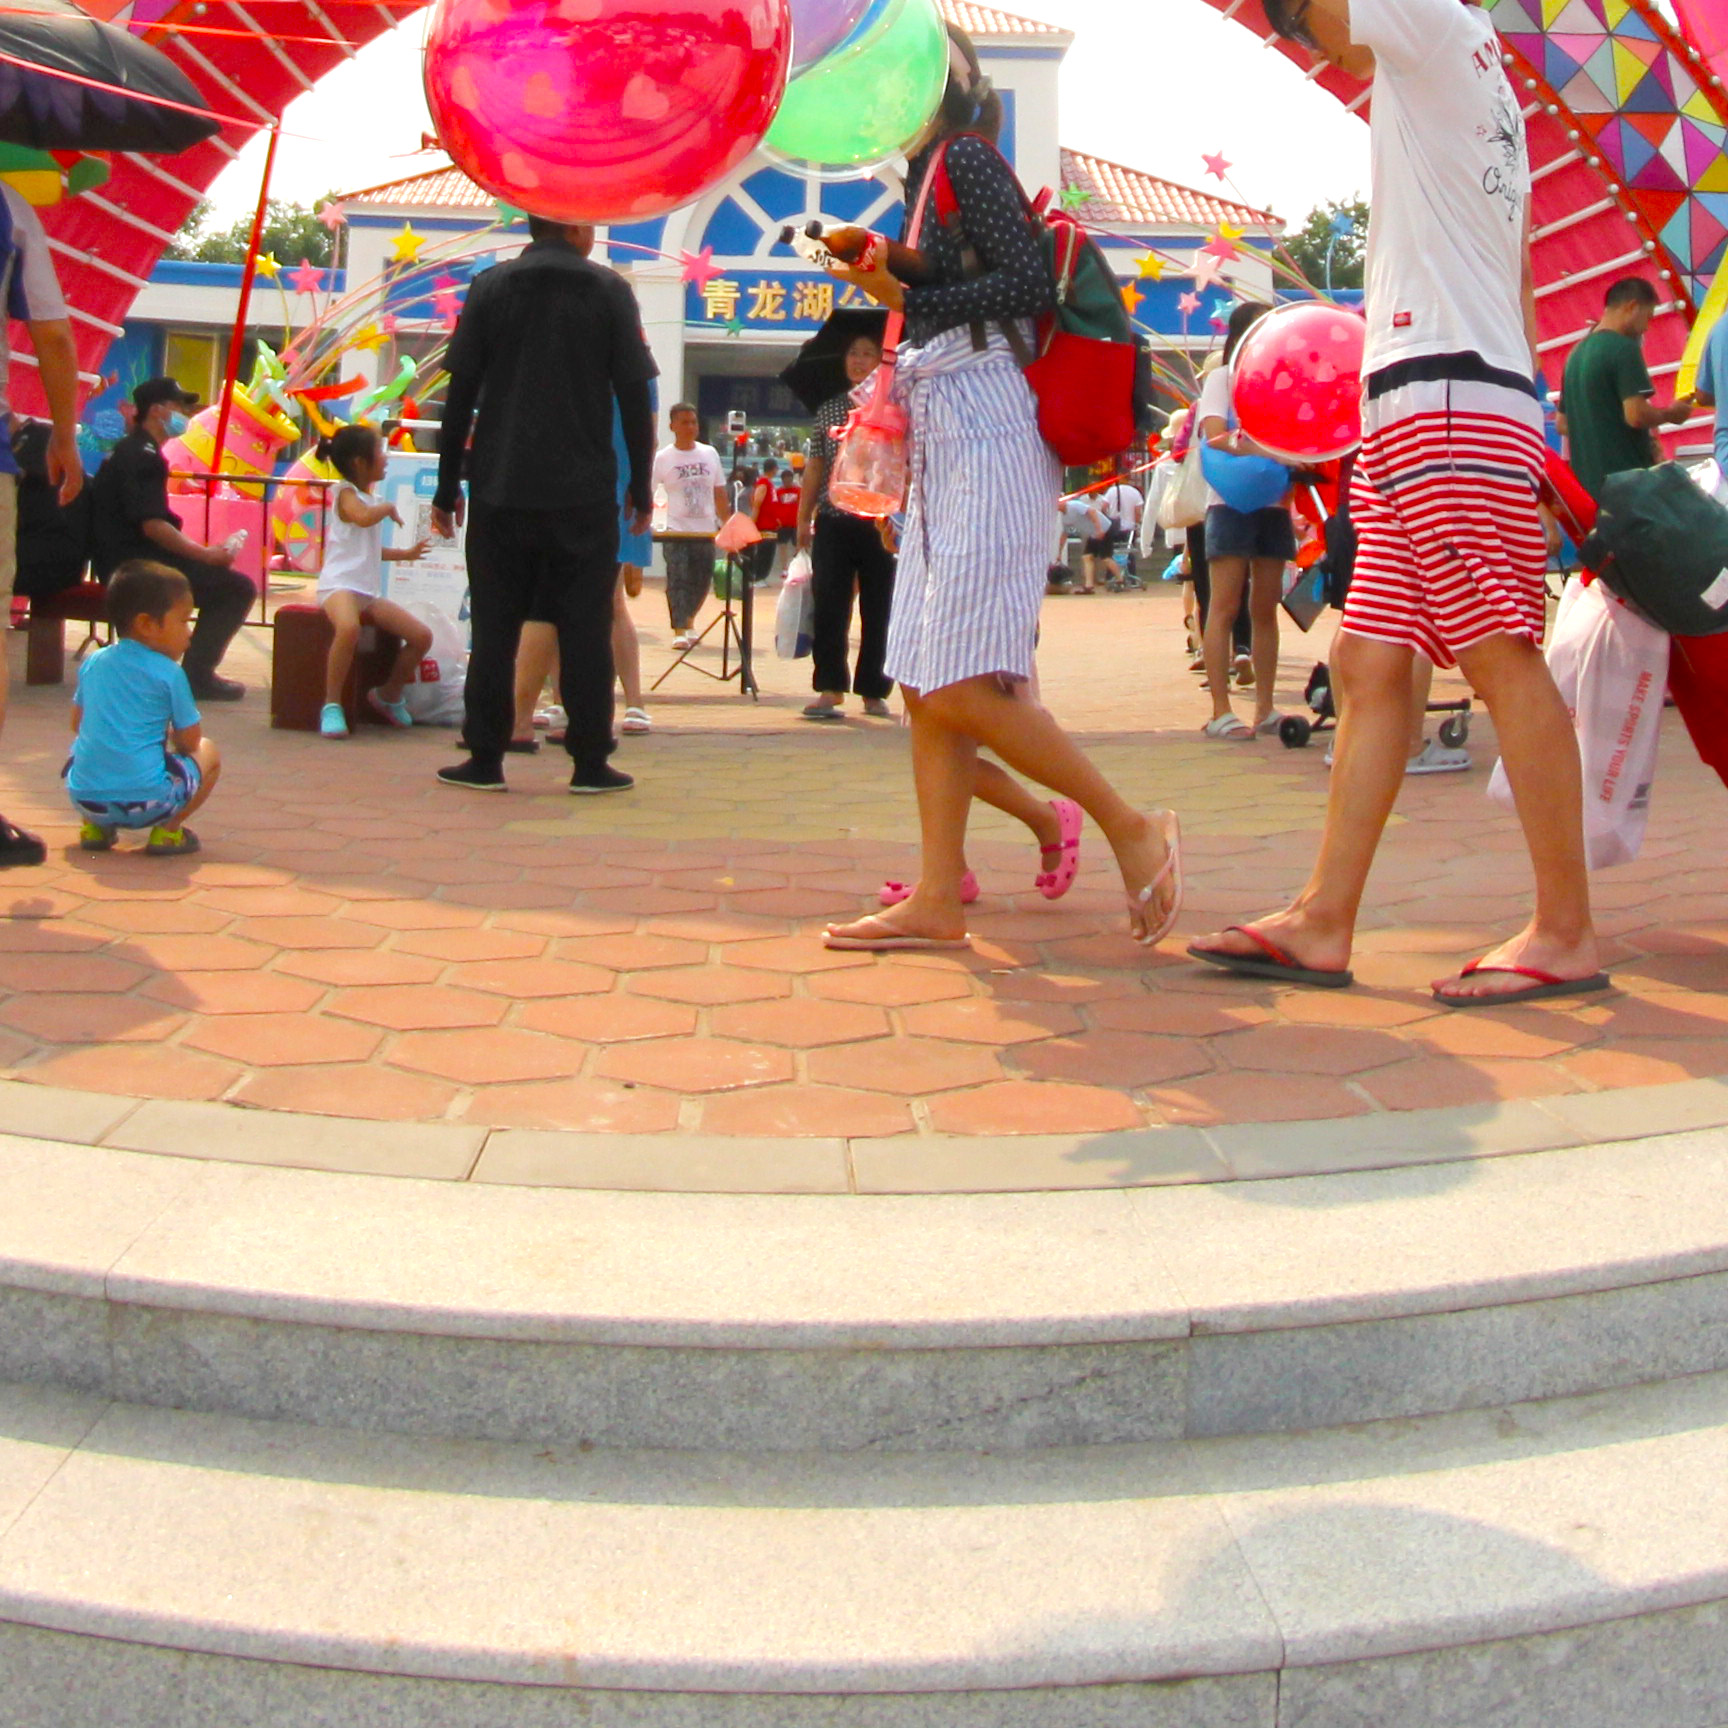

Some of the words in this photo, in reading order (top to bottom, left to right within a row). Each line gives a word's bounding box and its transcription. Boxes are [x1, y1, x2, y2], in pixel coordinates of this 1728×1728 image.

[1631, 671, 1653, 703] MAKE
[1617, 704, 1642, 747] SPORTS
[1607, 749, 1627, 778] YOUR
[1599, 778, 1616, 804] LIFE
